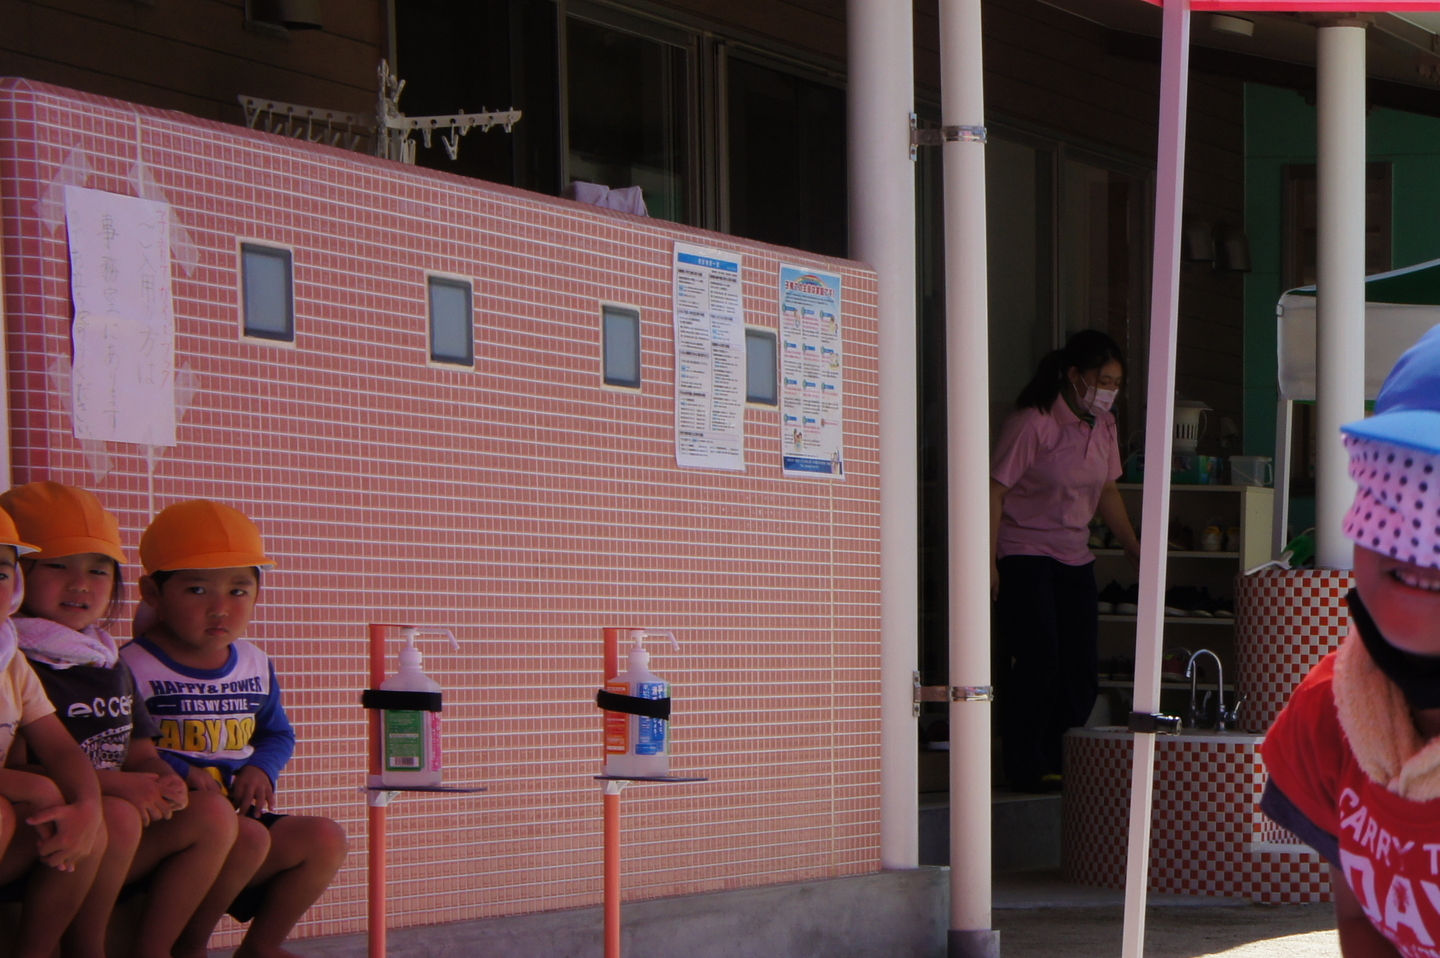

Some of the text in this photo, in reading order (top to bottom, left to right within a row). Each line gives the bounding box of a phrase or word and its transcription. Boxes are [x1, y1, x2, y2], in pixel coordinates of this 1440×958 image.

[149, 676, 263, 695] HAPPY & POWER
[180, 698, 248, 712] IT IS MY STYLE
[157, 718, 222, 753] ABY
[1339, 787, 1415, 871] CARRY
